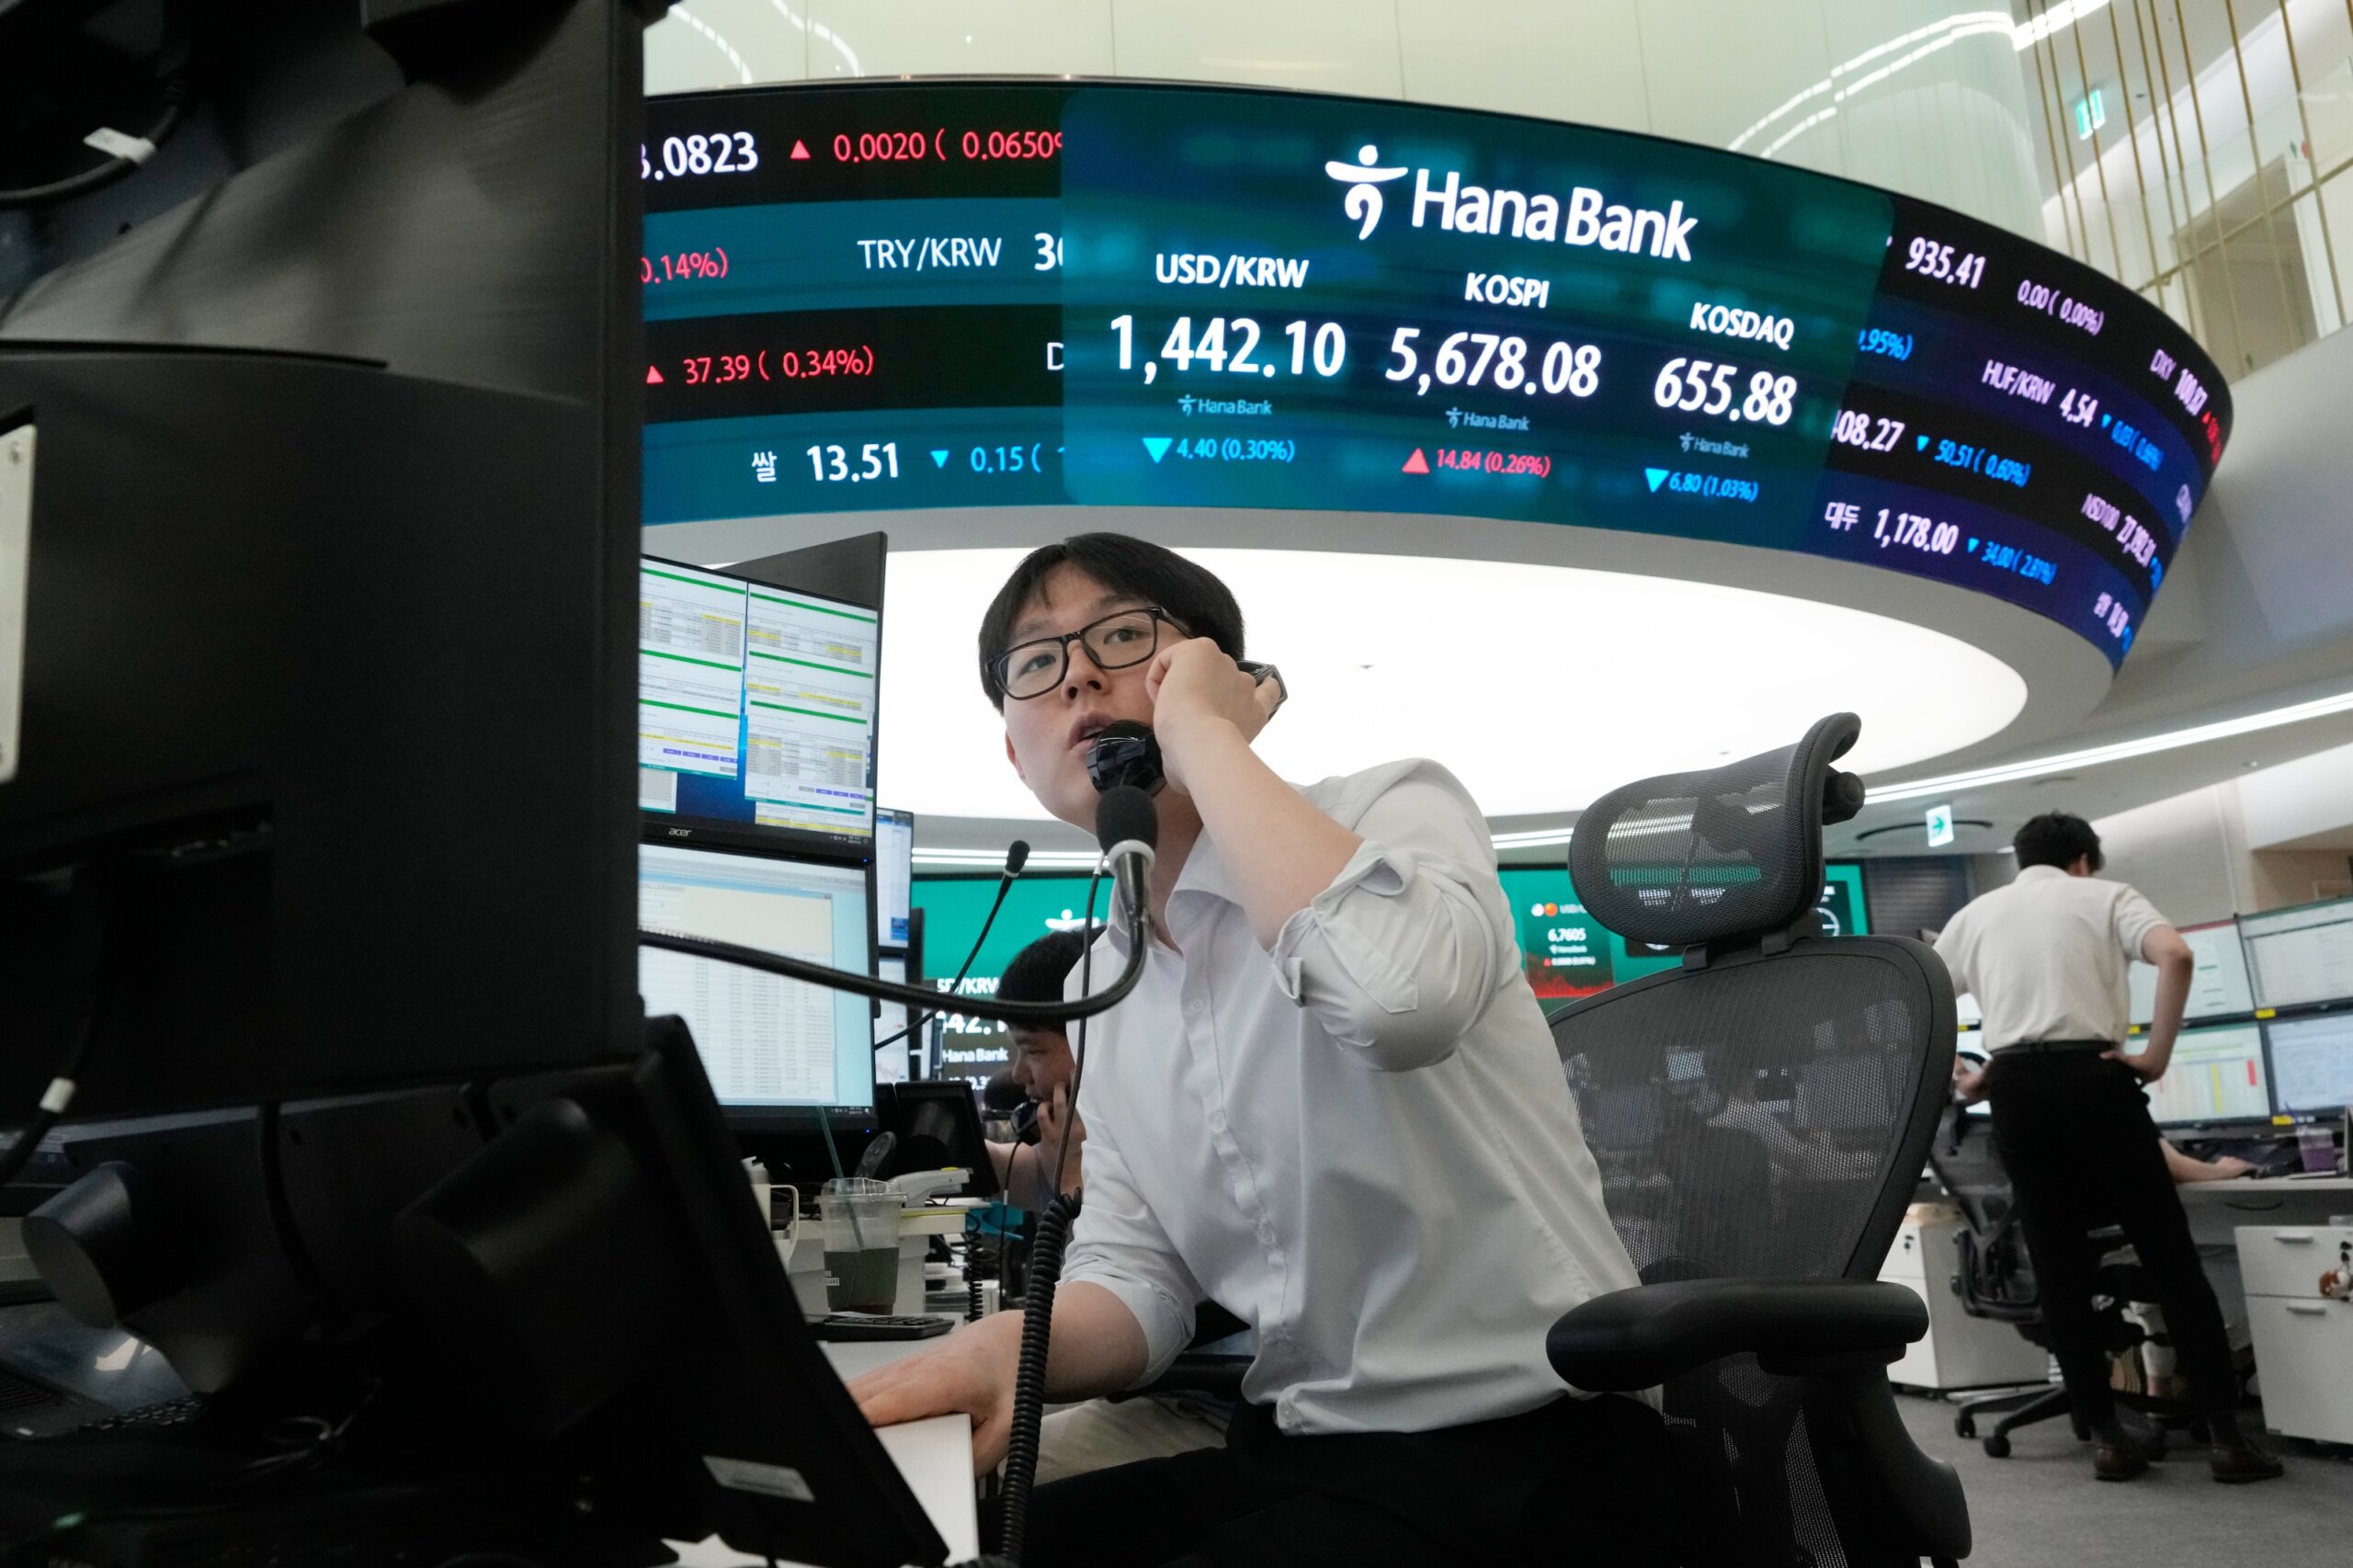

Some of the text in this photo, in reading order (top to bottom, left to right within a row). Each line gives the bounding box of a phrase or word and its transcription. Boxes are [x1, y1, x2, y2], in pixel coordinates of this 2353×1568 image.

[834, 131, 926, 163] 0.0020
[962, 131, 1063, 161] 0.0650
[1411, 167, 1699, 262] Hana Bank
[857, 232, 1064, 272] TRY/KRW 3
[1155, 253, 1310, 289] USD/KRW
[1905, 236, 1986, 289] 935.41
[1464, 272, 1551, 309] KOSPI
[1689, 301, 1795, 351] KOSDAQ
[683, 355, 751, 384] 37.39
[782, 345, 874, 379] 0.34%)
[1110, 314, 1347, 385] 1,442.10
[1384, 326, 1602, 398] 5,678.08
[1197, 398, 1272, 415] Hana Bank
[1654, 357, 1798, 426] 655.88
[1982, 359, 2056, 404] HUF/KRW
[2059, 388, 2098, 427] 4.54
[751, 450, 778, 483] 쌀
[806, 442, 899, 483] 13.51
[970, 446, 1024, 474] 0.15
[1176, 437, 1296, 462] 4.40 (0.30%)
[1438, 449, 1551, 478] 14.84 (0.26%)
[1934, 438, 1974, 470] 50.51
[1669, 471, 1759, 503] 6.80 (1.03%)
[1824, 501, 1861, 531] 대두
[1873, 508, 1960, 555] 1,178.00
[668, 827, 692, 837] acer
[976, 1047, 1009, 1062] Bank
